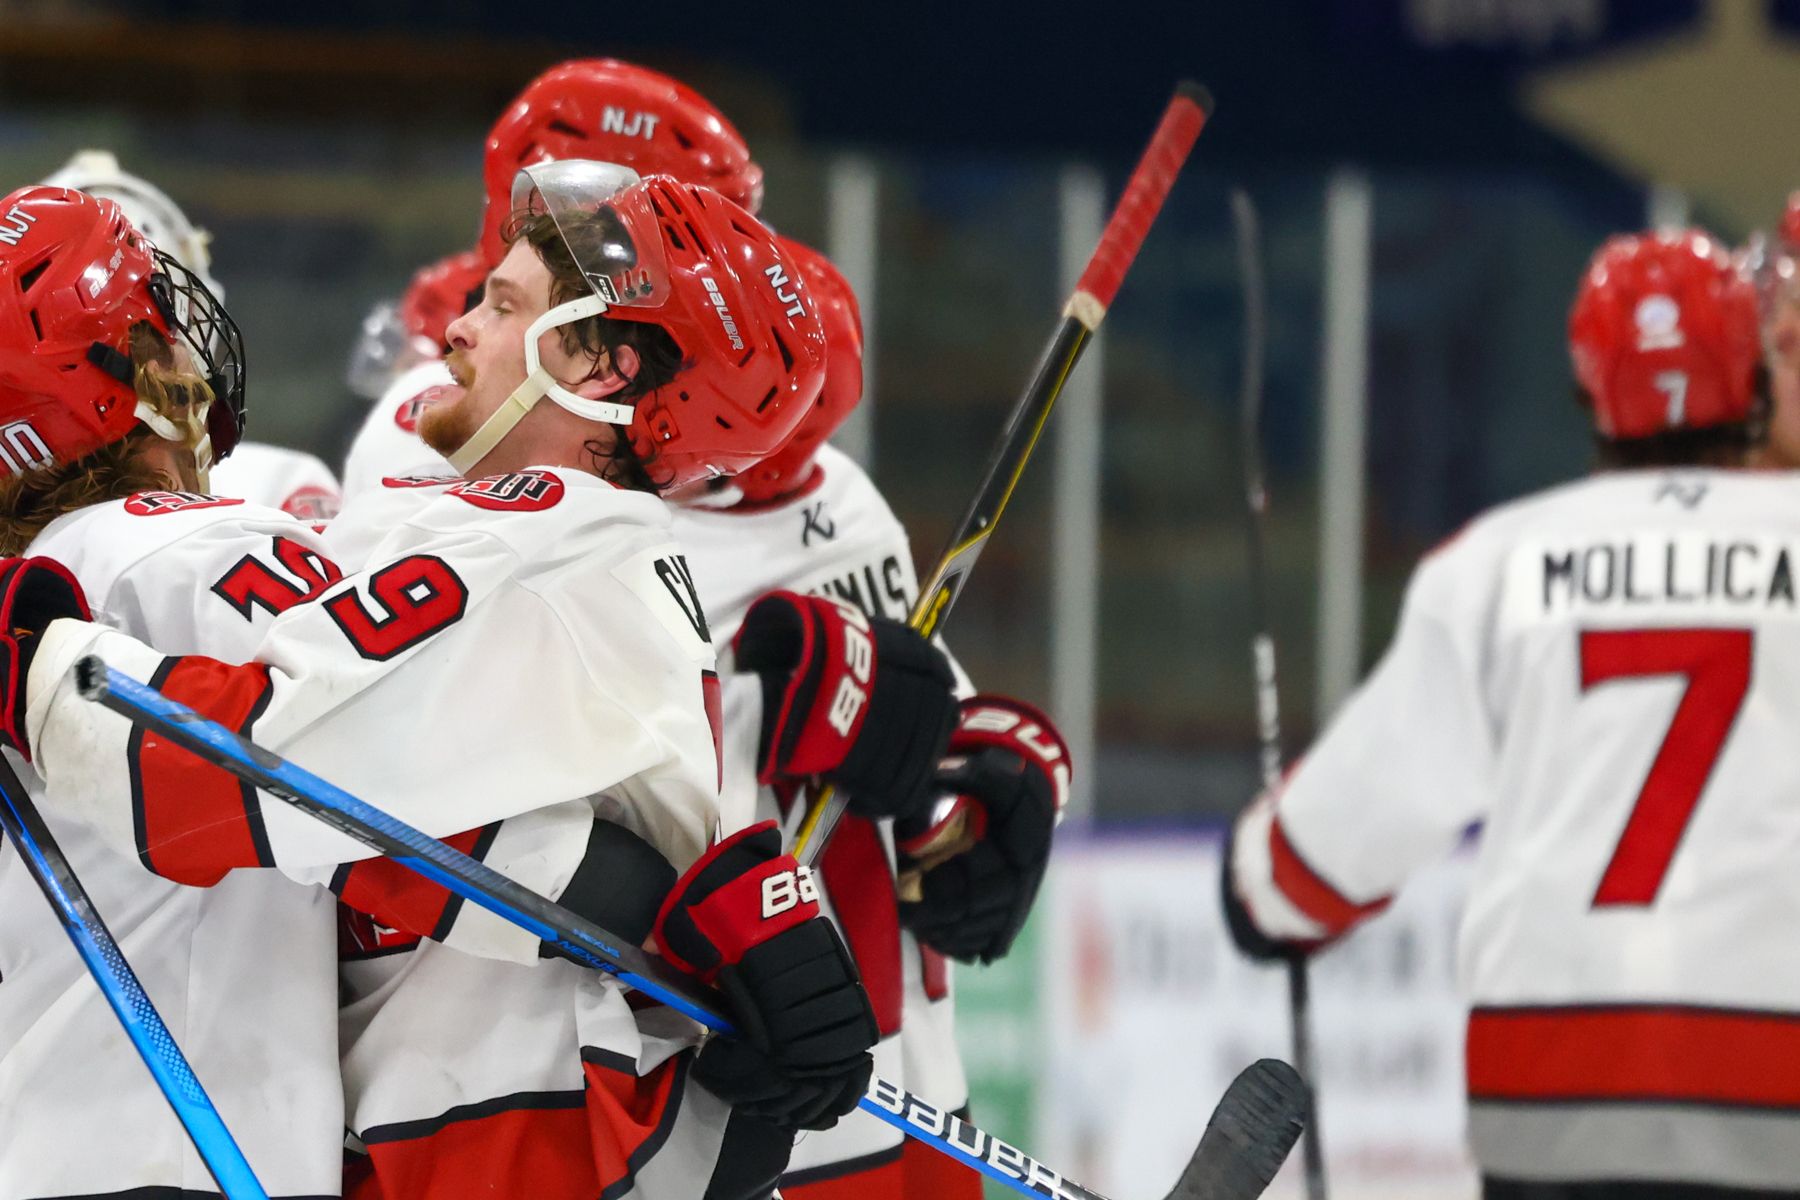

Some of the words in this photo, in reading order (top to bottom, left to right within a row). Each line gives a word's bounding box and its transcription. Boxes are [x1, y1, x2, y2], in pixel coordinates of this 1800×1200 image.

[602, 105, 660, 141] NJT
[765, 264, 807, 319] NJT
[1655, 369, 1688, 427] 7
[1543, 541, 1798, 610] MOLLICA
[322, 555, 468, 661] 9
[1577, 627, 1756, 911] 7
